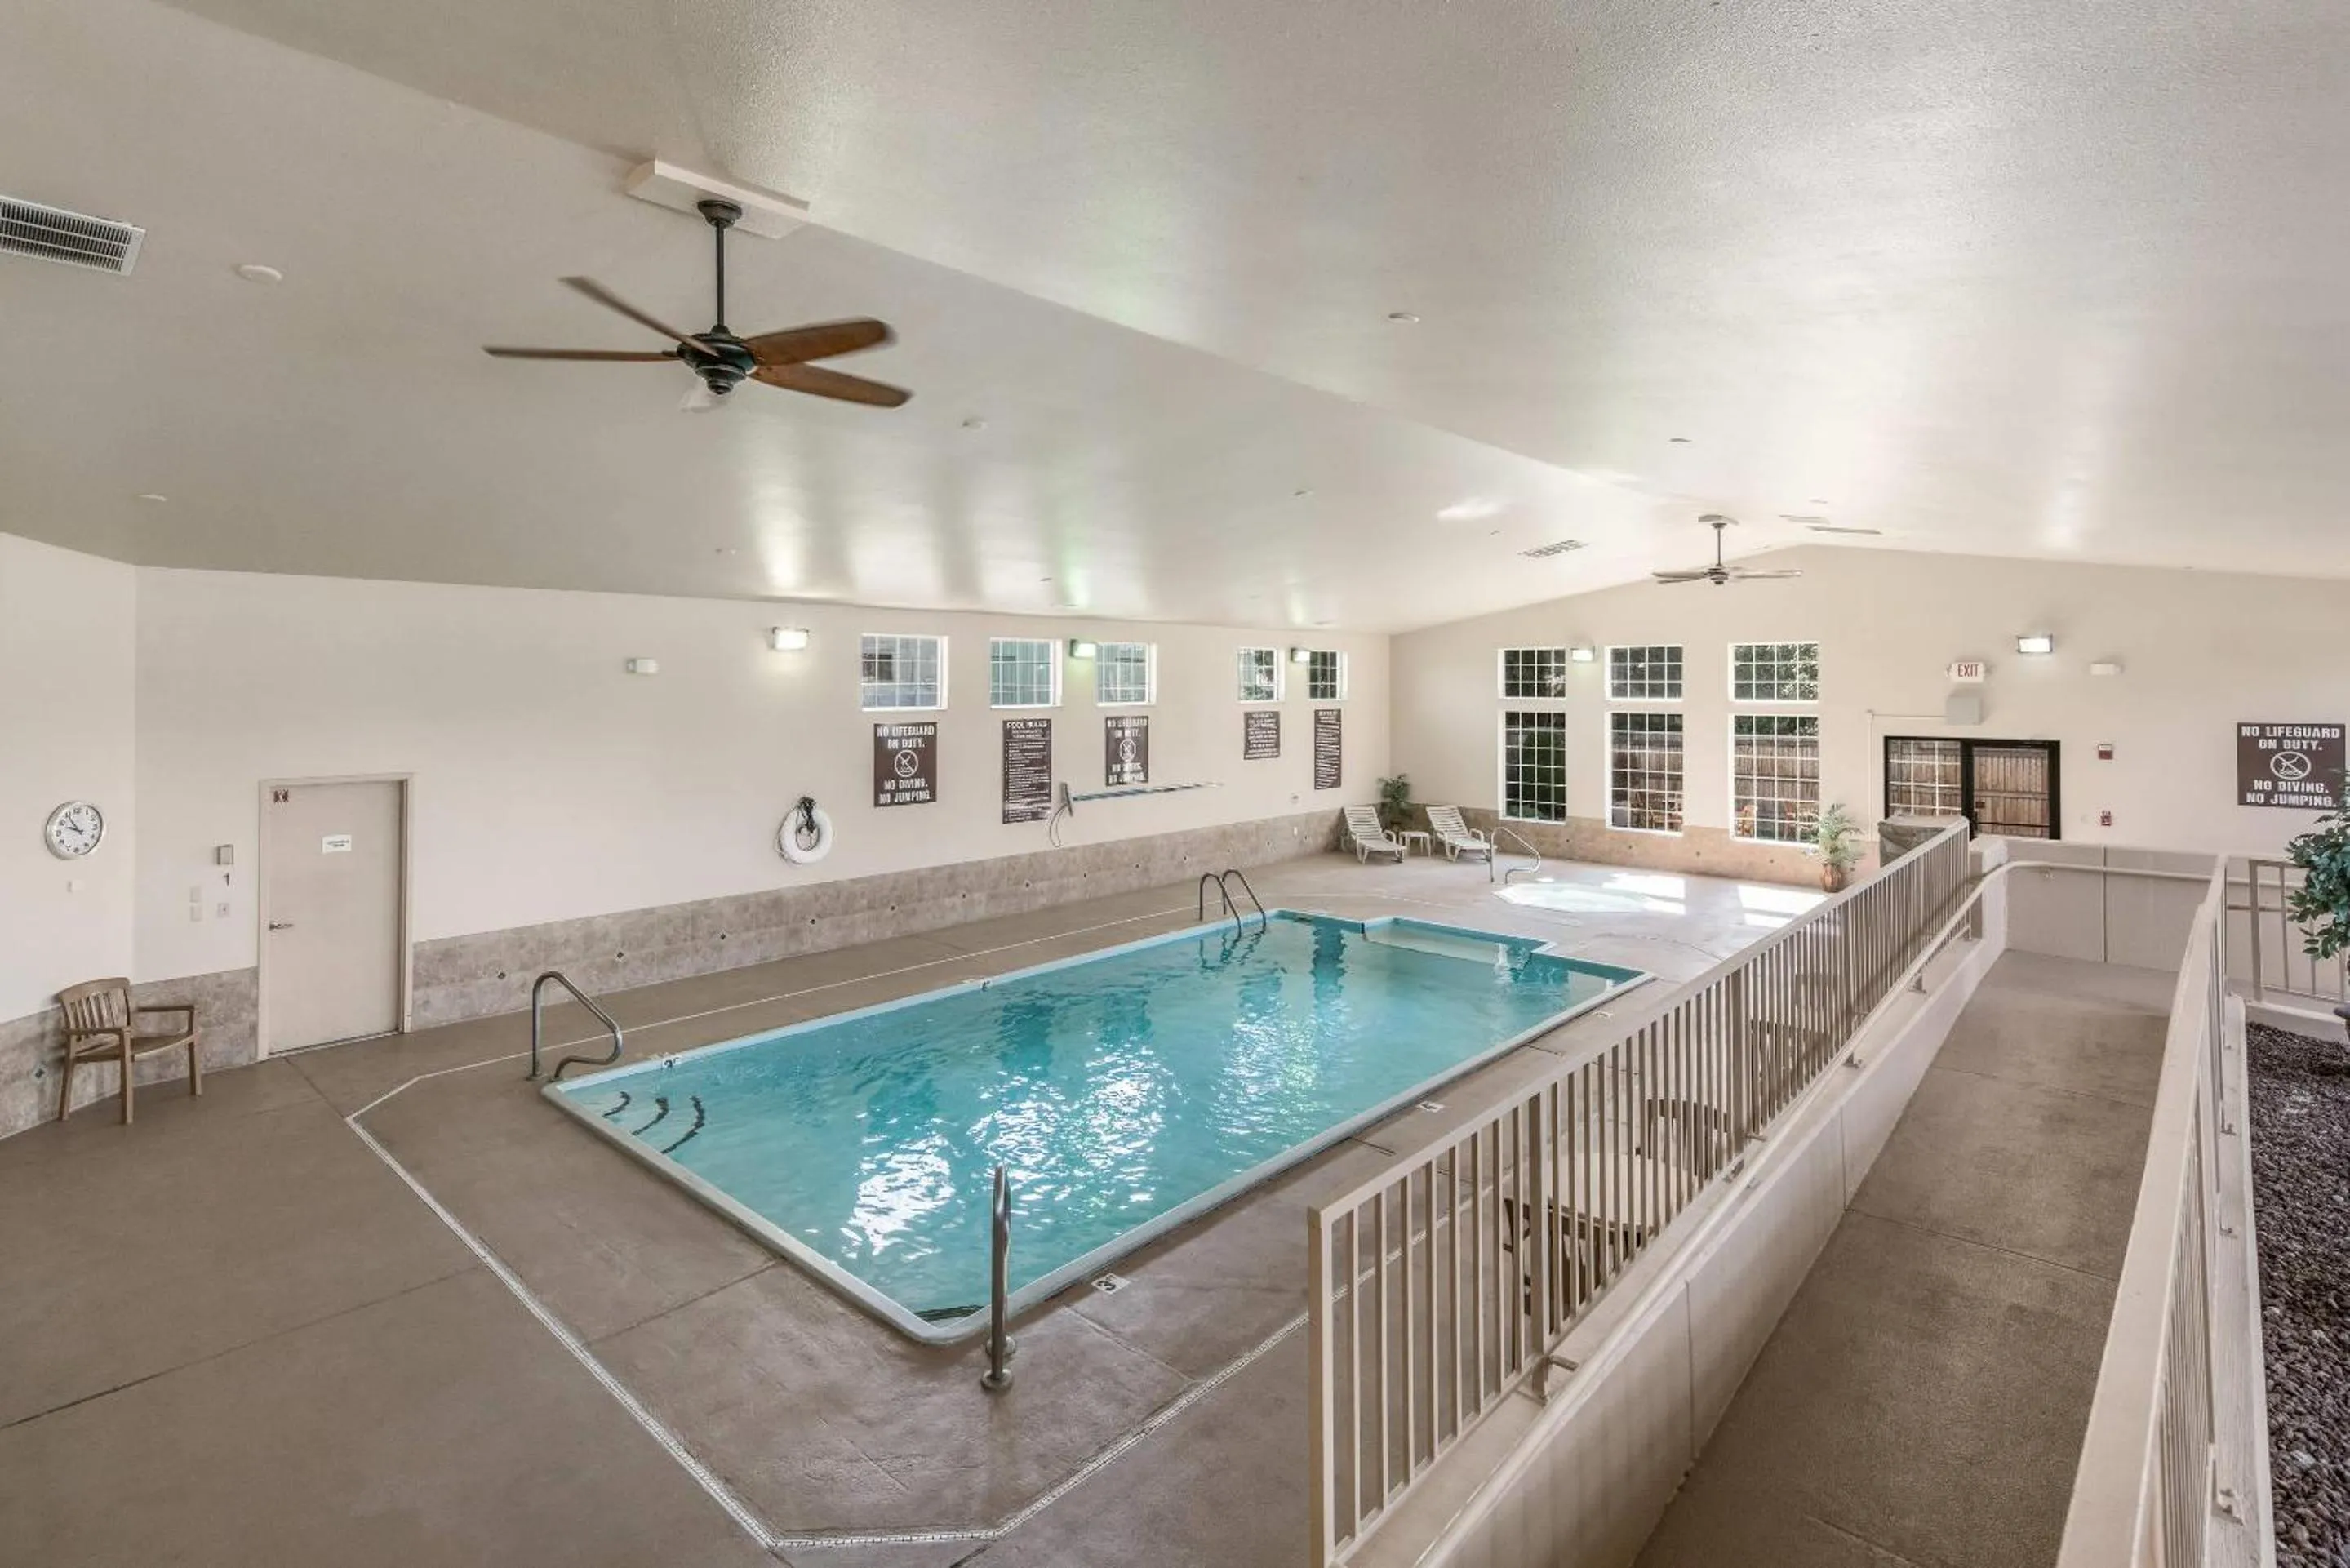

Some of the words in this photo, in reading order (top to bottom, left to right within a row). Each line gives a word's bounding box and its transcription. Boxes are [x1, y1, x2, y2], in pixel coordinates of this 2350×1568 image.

[1958, 664, 1979, 677] EXIT
[877, 726, 889, 737] NO
[2241, 726, 2260, 737] NO
[2266, 726, 2341, 739] LIFEGUARD
[2259, 739, 2277, 750] ON
[2283, 739, 2323, 751] DUTY.
[2254, 780, 2272, 791] NO
[2278, 780, 2330, 793] DIVING.
[2246, 793, 2265, 803] NO
[2270, 793, 2337, 807] JUMPING.
